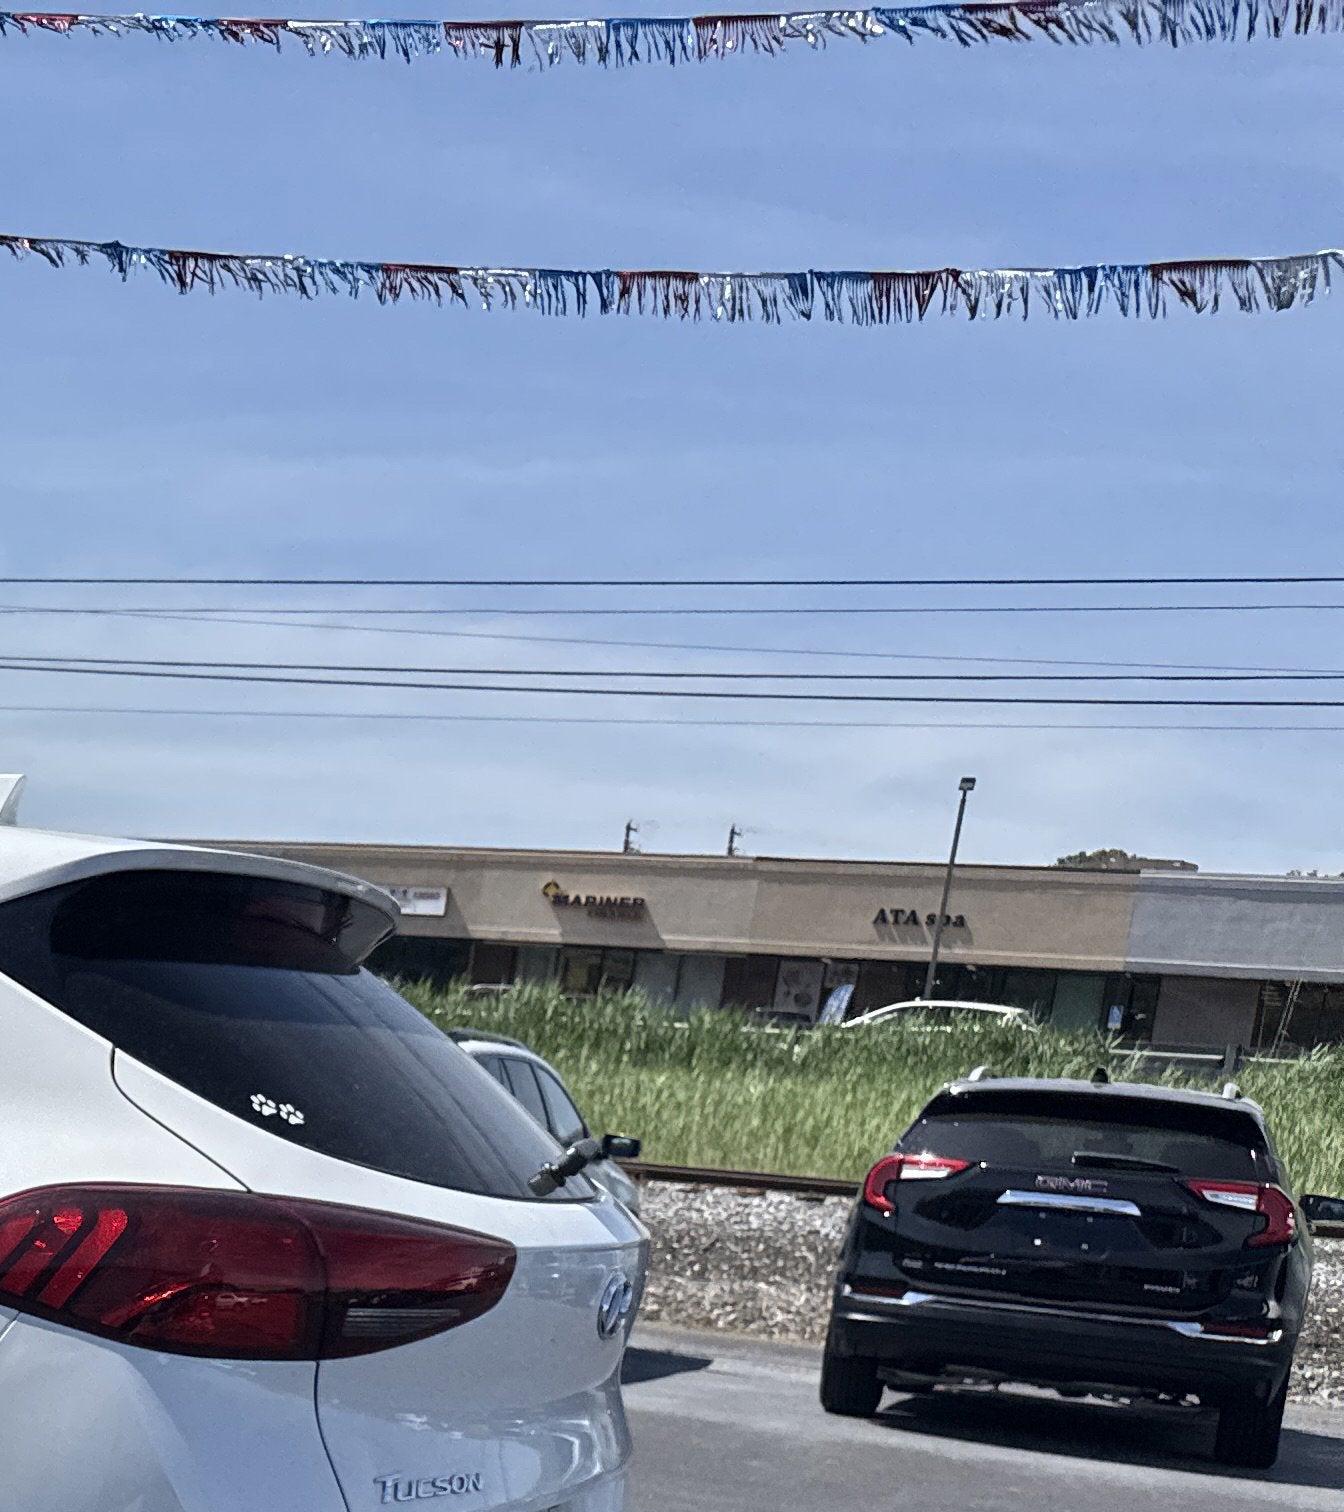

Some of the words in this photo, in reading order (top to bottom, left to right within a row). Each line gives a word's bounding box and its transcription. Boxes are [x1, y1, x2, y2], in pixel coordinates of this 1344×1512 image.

[552, 894, 645, 907] MARINER
[873, 908, 920, 925] ATA
[1035, 1174, 1108, 1192] GMC
